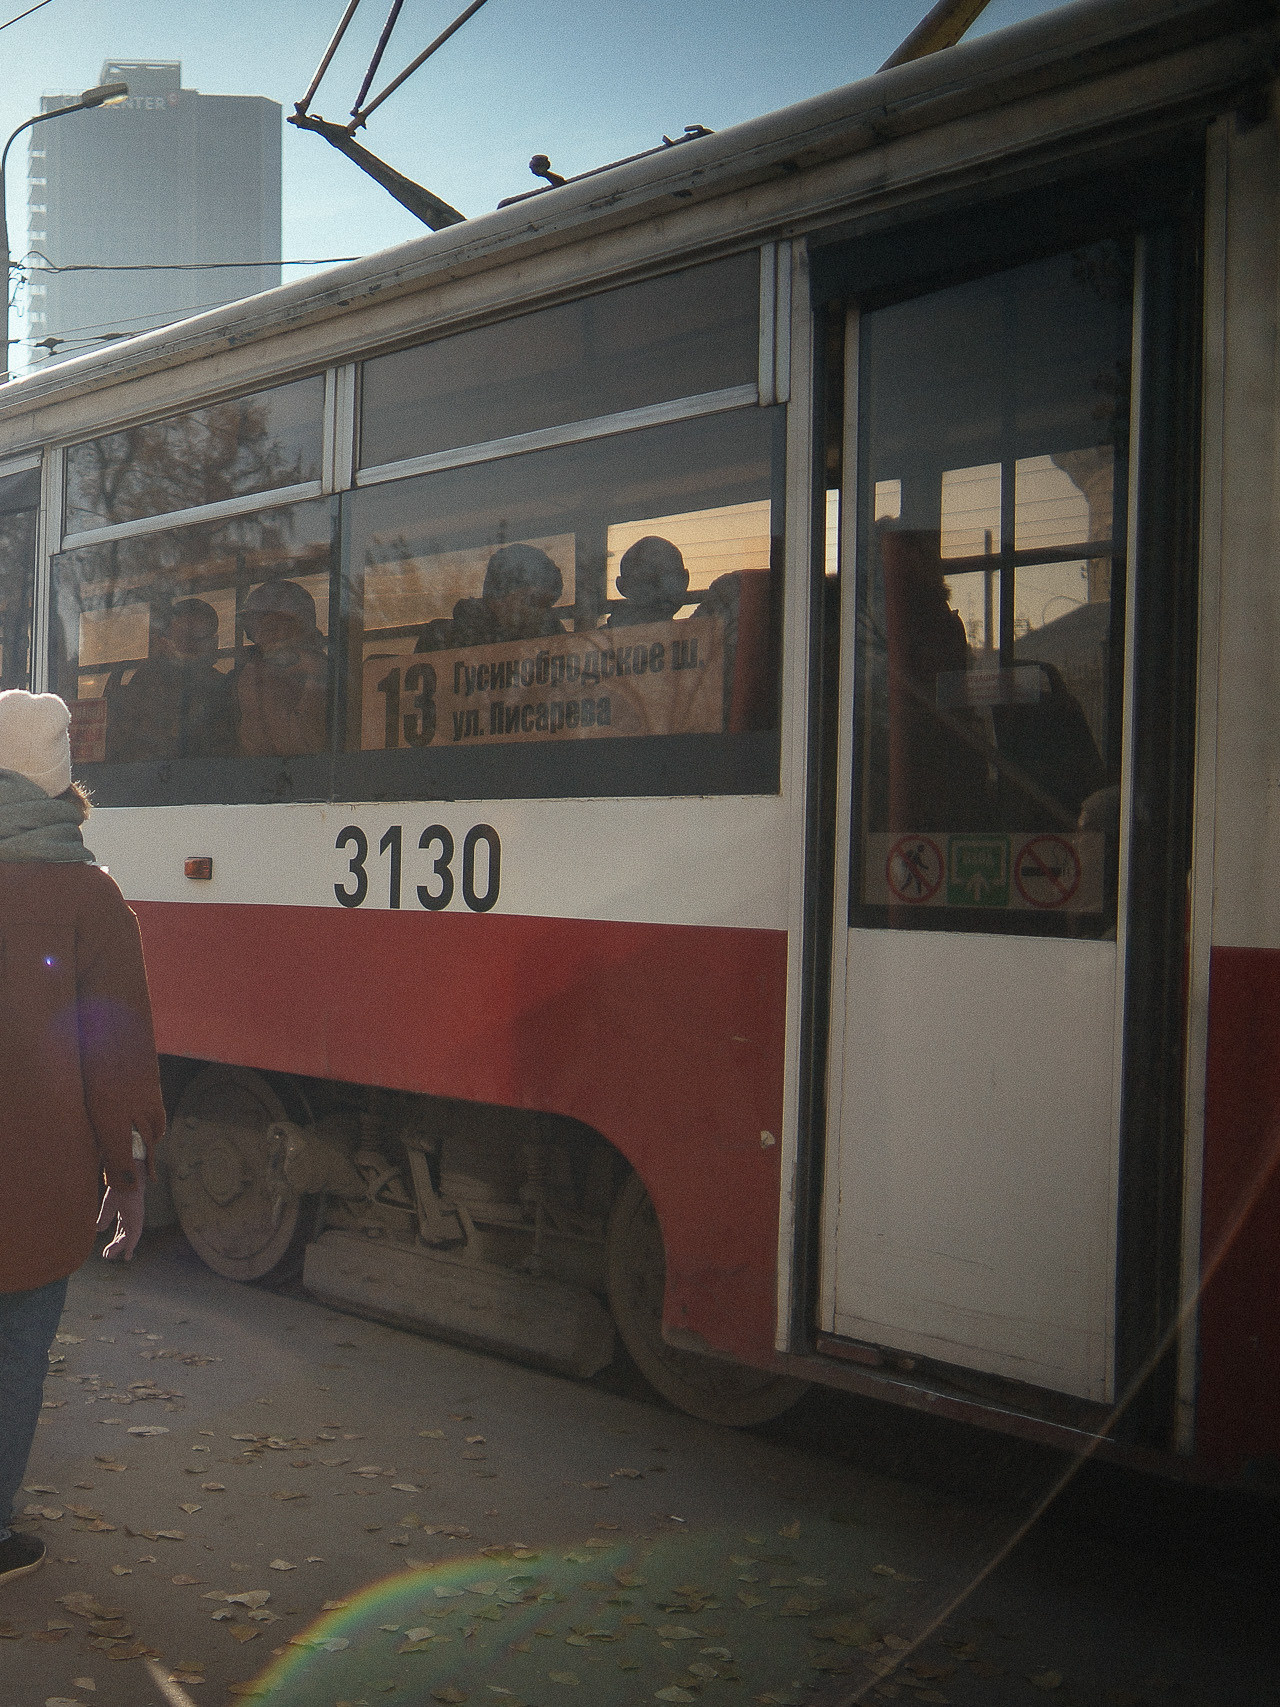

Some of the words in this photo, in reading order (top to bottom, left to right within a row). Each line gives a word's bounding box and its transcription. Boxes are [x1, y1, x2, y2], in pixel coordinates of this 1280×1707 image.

[377, 663, 437, 748] 13
[453, 641, 665, 697] Гусинобродское
[452, 709, 485, 742] ул.
[489, 697, 612, 735] Писарева
[334, 823, 502, 913] 3130
